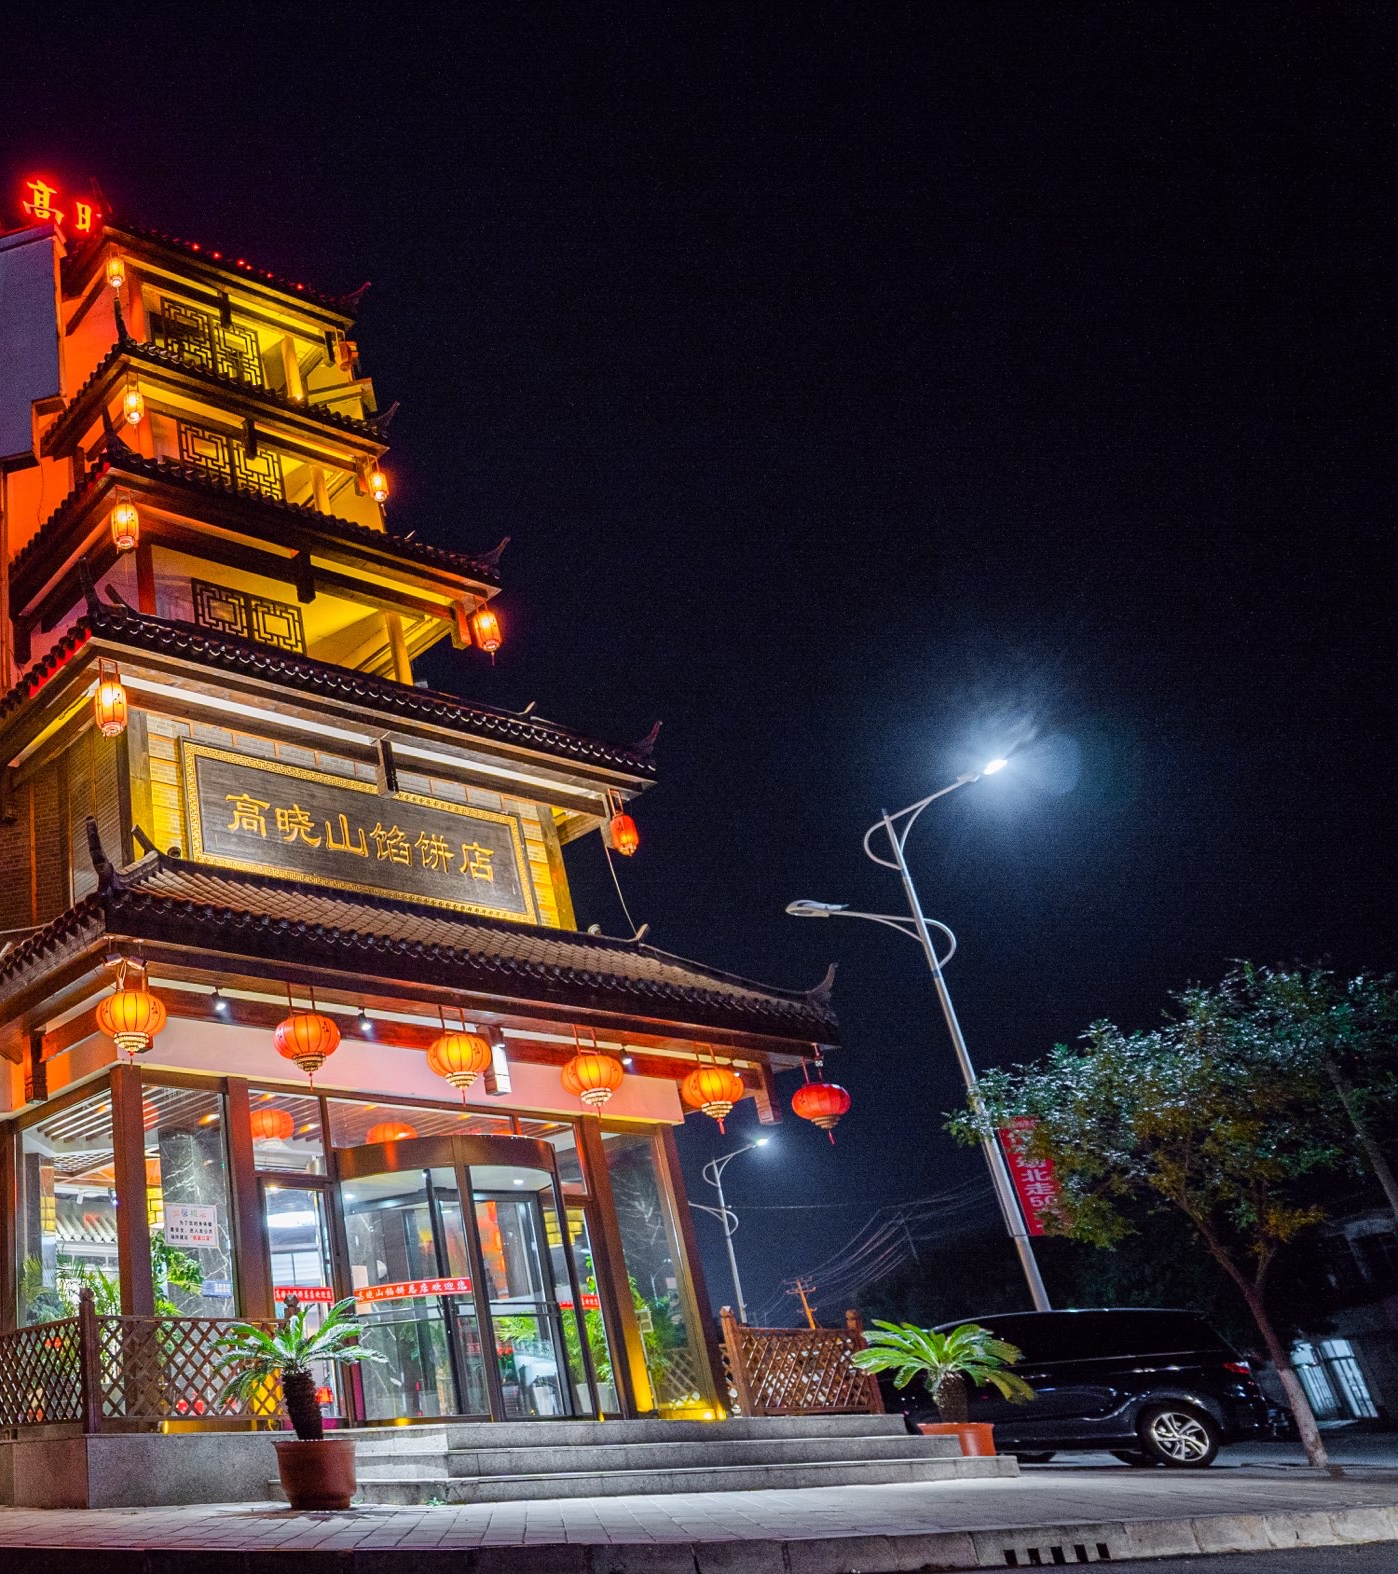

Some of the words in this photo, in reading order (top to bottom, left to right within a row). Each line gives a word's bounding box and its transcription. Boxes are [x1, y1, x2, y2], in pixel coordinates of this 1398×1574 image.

[225, 793, 495, 883] 高晓山馅饼店
